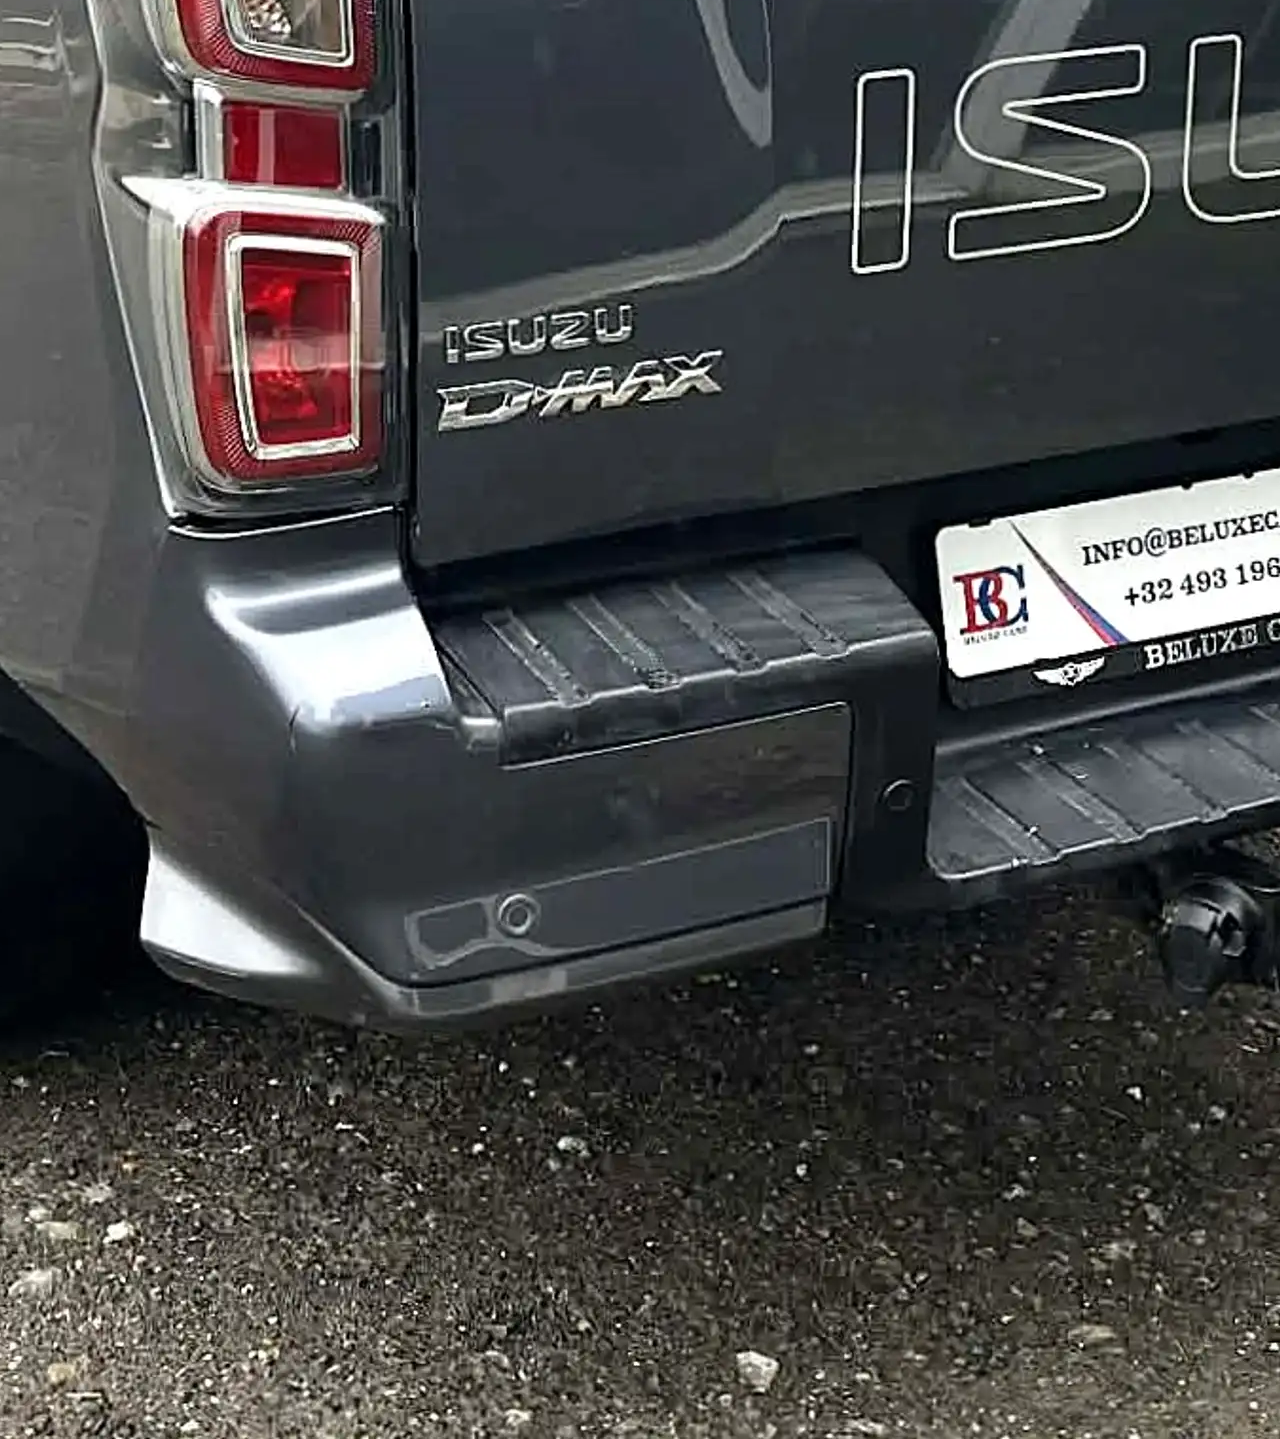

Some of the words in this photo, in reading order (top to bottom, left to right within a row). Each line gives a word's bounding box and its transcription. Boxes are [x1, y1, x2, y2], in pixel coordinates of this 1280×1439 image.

[444, 304, 633, 364] ISUZU
[1124, 578, 1174, 607] +32
[1180, 567, 1228, 597] 493
[1143, 624, 1258, 670] BELUXE
